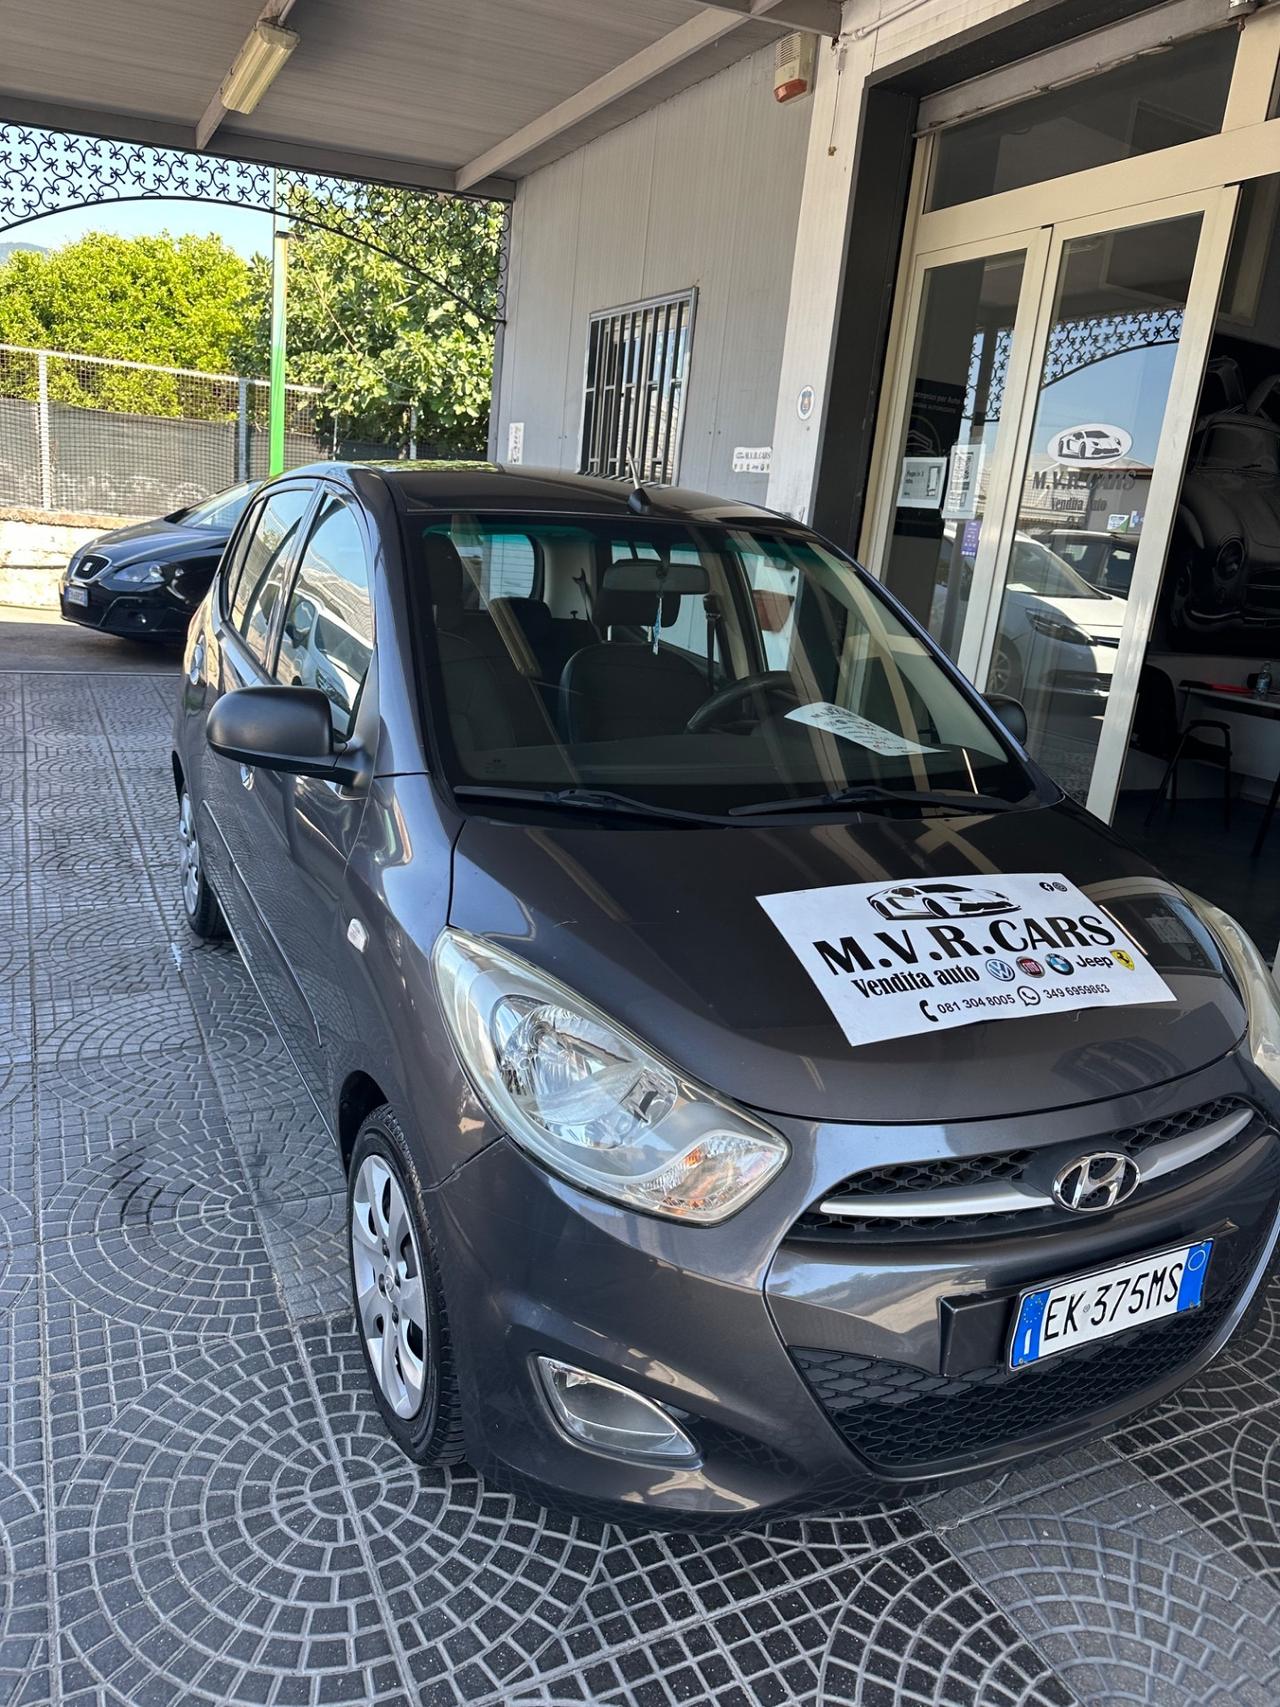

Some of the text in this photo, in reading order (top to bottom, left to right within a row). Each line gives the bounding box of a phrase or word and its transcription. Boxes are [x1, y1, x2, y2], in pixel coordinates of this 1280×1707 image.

[1076, 954, 1114, 968] Jeep
[851, 964, 980, 999] Vendita auto
[1043, 983, 1111, 999] 349 6959863
[936, 993, 1016, 1015] 081 304 8005
[1044, 1263, 1184, 1342] EK 375MS
